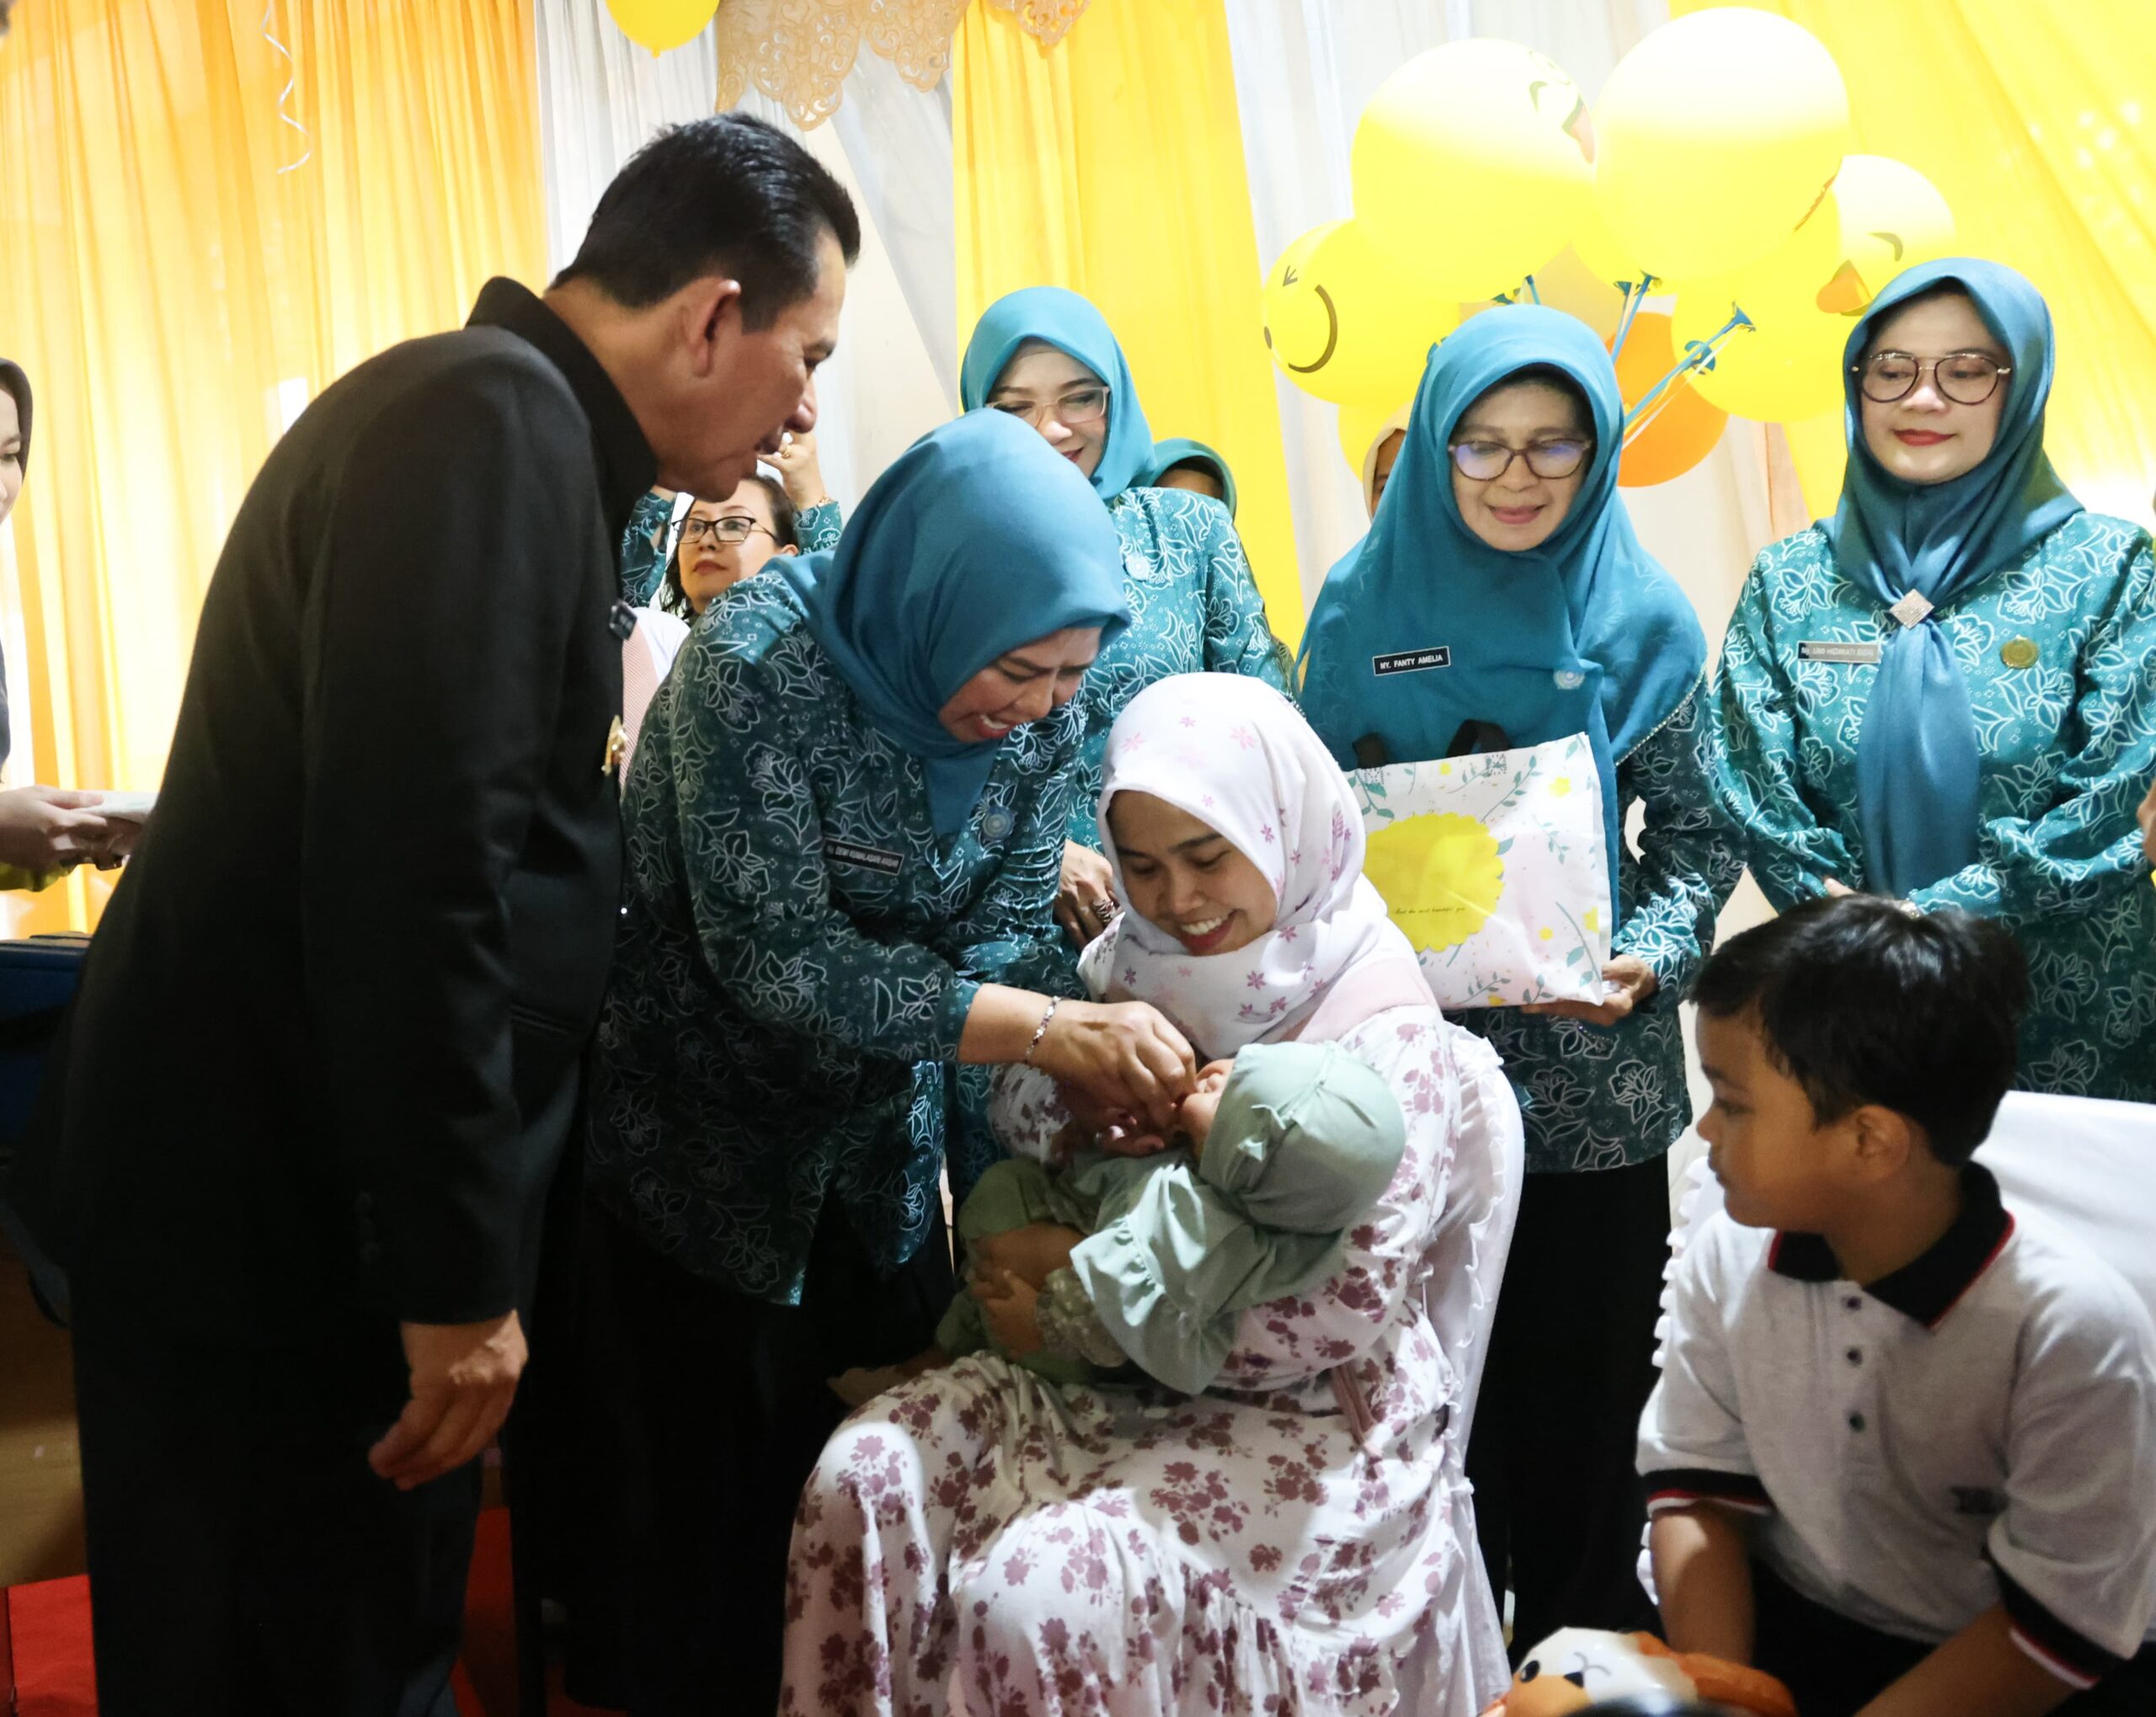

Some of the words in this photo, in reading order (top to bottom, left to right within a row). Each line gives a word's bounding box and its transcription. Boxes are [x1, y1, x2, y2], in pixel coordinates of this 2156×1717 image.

[1380, 661, 1391, 669] NY.
[1394, 658, 1415, 668] FANTY
[1417, 653, 1444, 665] AMELIA
